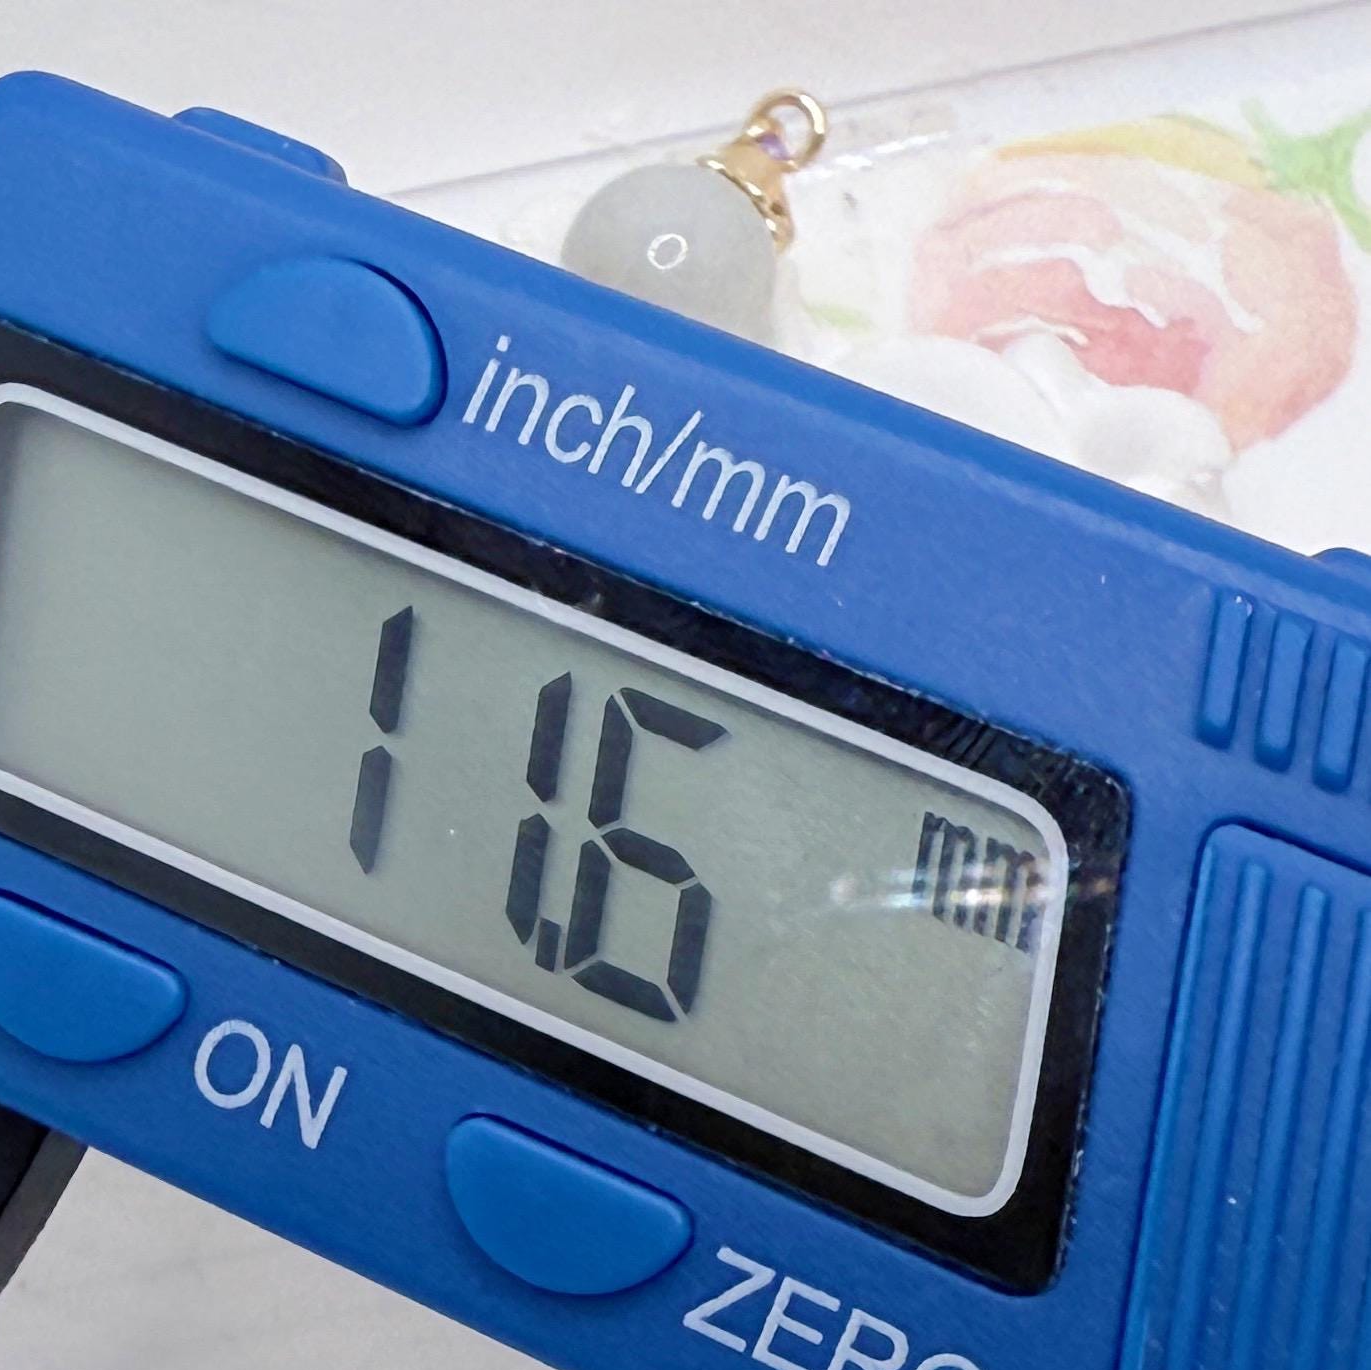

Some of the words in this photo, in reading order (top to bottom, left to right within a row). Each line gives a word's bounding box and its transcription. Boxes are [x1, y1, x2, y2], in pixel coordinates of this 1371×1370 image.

[461, 335, 852, 567] inch/mm
[349, 604, 729, 1024] 11.6
[193, 1018, 348, 1150] ON
